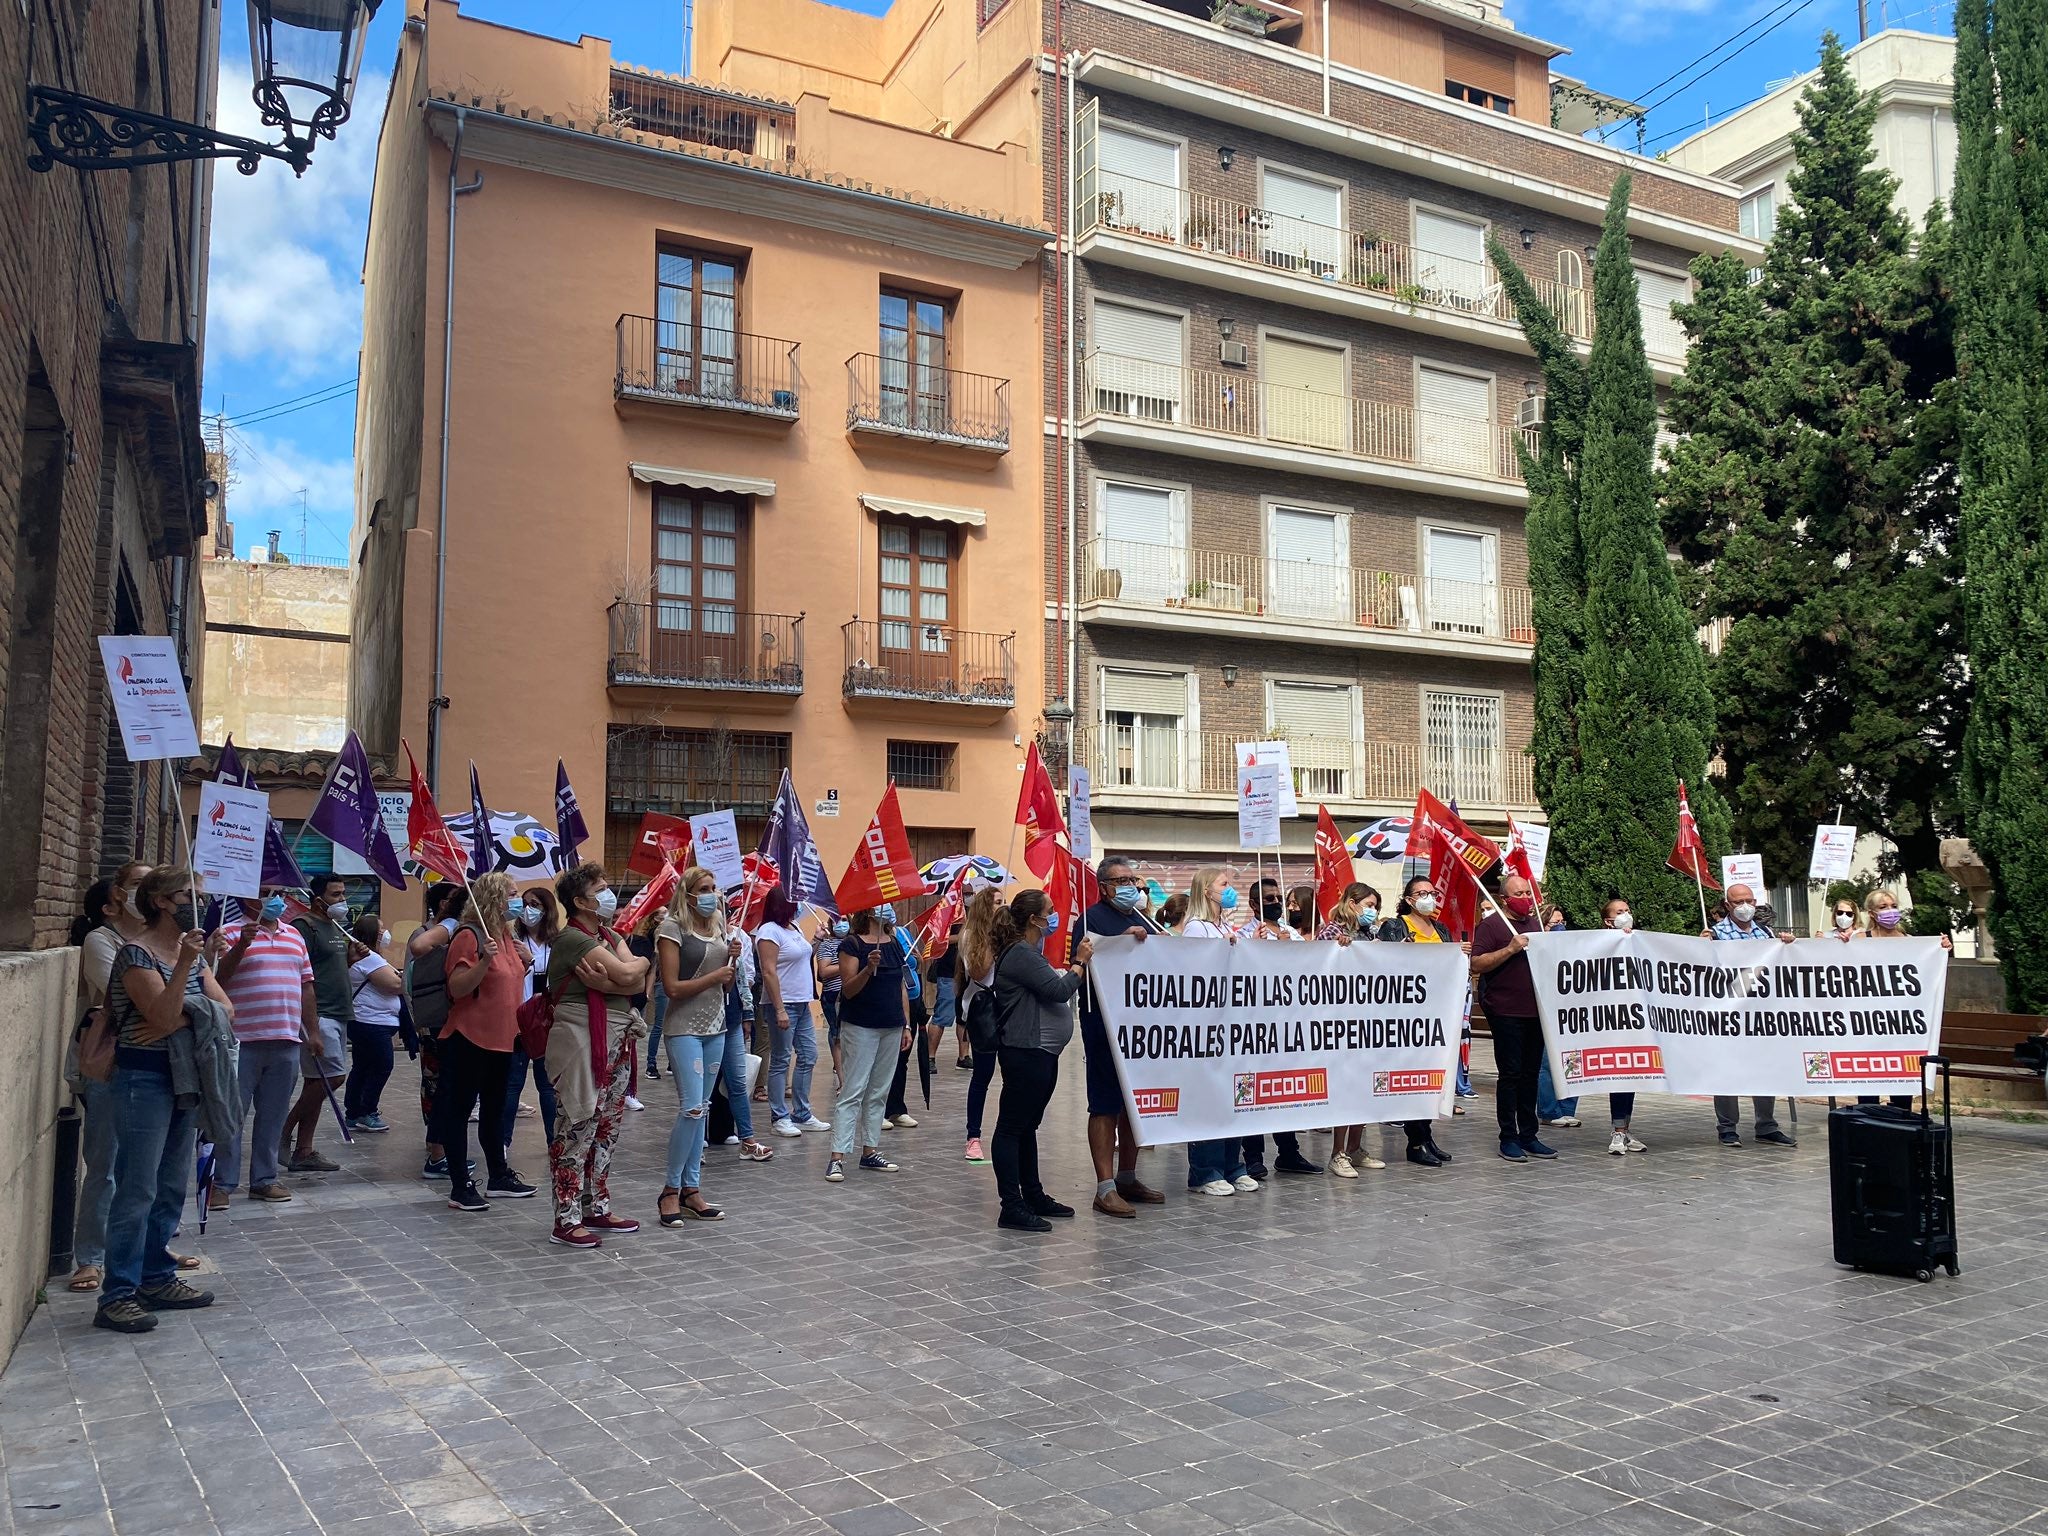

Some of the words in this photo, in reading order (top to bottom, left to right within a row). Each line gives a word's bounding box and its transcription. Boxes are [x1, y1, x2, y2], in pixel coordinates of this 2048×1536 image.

[378, 797, 405, 805] ICIO
[1124, 972, 1228, 1008] IGUALDAD
[1231, 975, 1257, 1007] EN
[1263, 974, 1293, 1007] LAS
[1298, 974, 1427, 1006] CONDICIONES
[1656, 960, 1771, 999] GESTIONES
[1775, 963, 1922, 999] INTEGRALES
[1557, 1006, 1590, 1035] POR
[1592, 1003, 1646, 1032] UNAS
[1647, 1003, 1741, 1037] ONDICIONES
[1744, 1010, 1847, 1037] LABORALES
[1849, 1008, 1928, 1036] DIGNAS
[1117, 1023, 1226, 1060] ABORALES
[1230, 1022, 1279, 1056] PARA
[1284, 1021, 1305, 1053] LA
[1310, 1017, 1447, 1051] DEPENDENCIA
[1586, 1051, 1650, 1071] CCOO
[1835, 1056, 1903, 1073] CCOO
[1259, 1076, 1307, 1098] CCOO
[1391, 1074, 1429, 1088] CCOO
